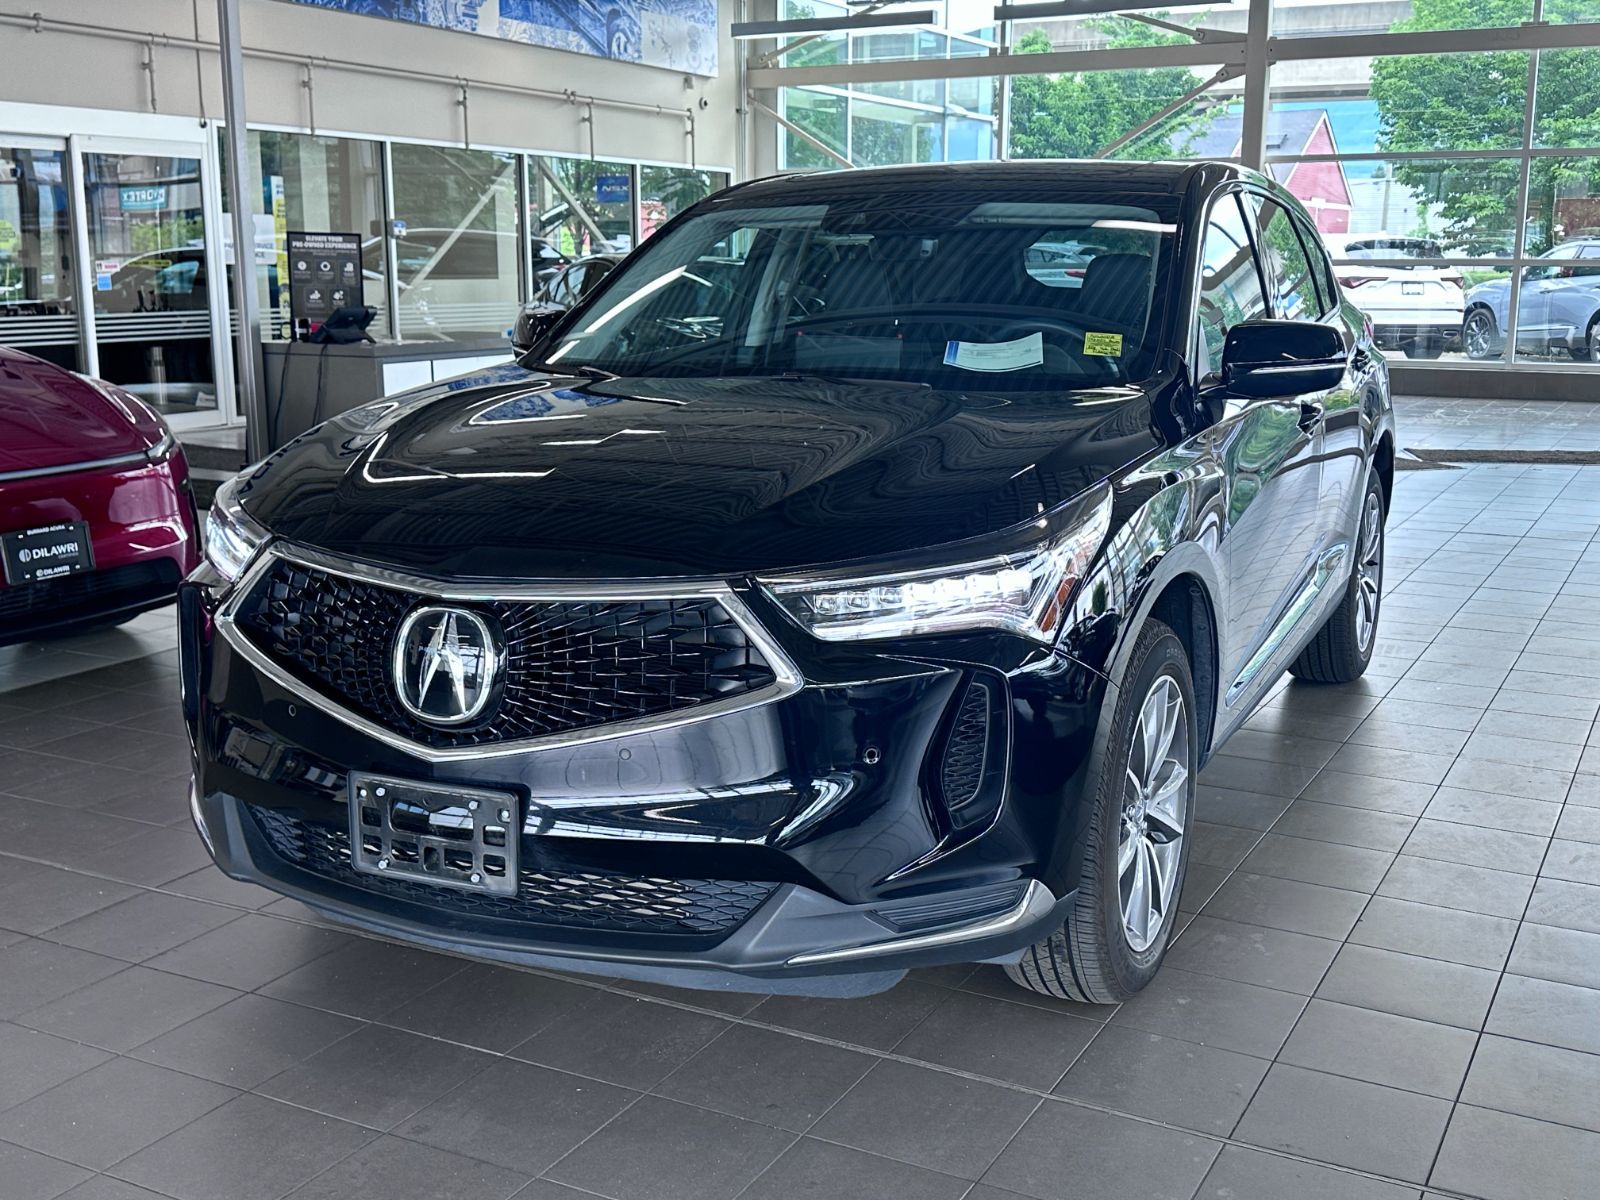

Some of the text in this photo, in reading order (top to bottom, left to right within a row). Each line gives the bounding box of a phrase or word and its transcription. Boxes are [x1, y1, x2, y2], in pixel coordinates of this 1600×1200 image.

[292, 241, 324, 249] PRE-OWNED
[32, 542, 79, 559] DILAWRI
[43, 565, 70, 575] DILAWRI
